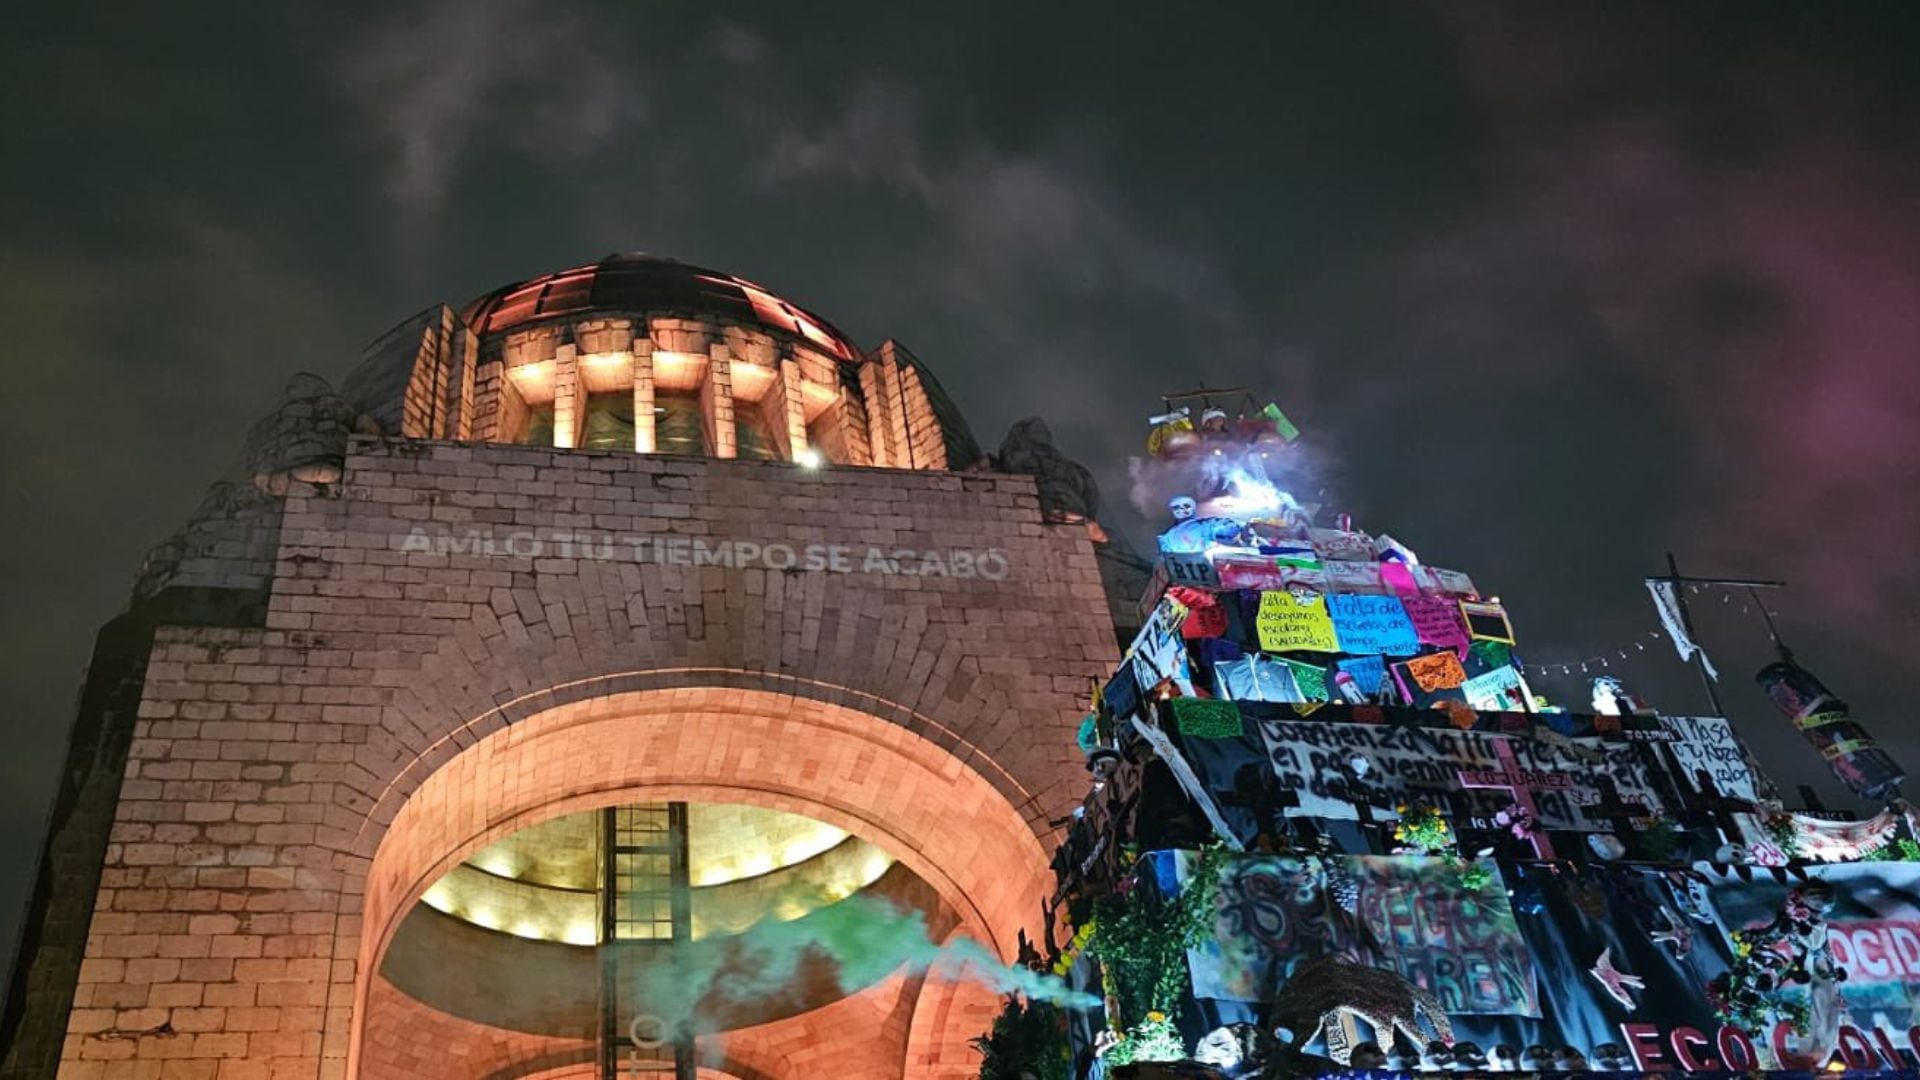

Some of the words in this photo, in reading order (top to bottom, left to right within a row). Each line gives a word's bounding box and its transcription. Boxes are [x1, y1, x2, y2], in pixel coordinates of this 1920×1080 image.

[551, 532, 614, 560] TU
[622, 536, 797, 570] TIEMPO
[804, 544, 853, 573] SE
[1174, 561, 1210, 581] RIP
[1380, 599, 1401, 615] de
